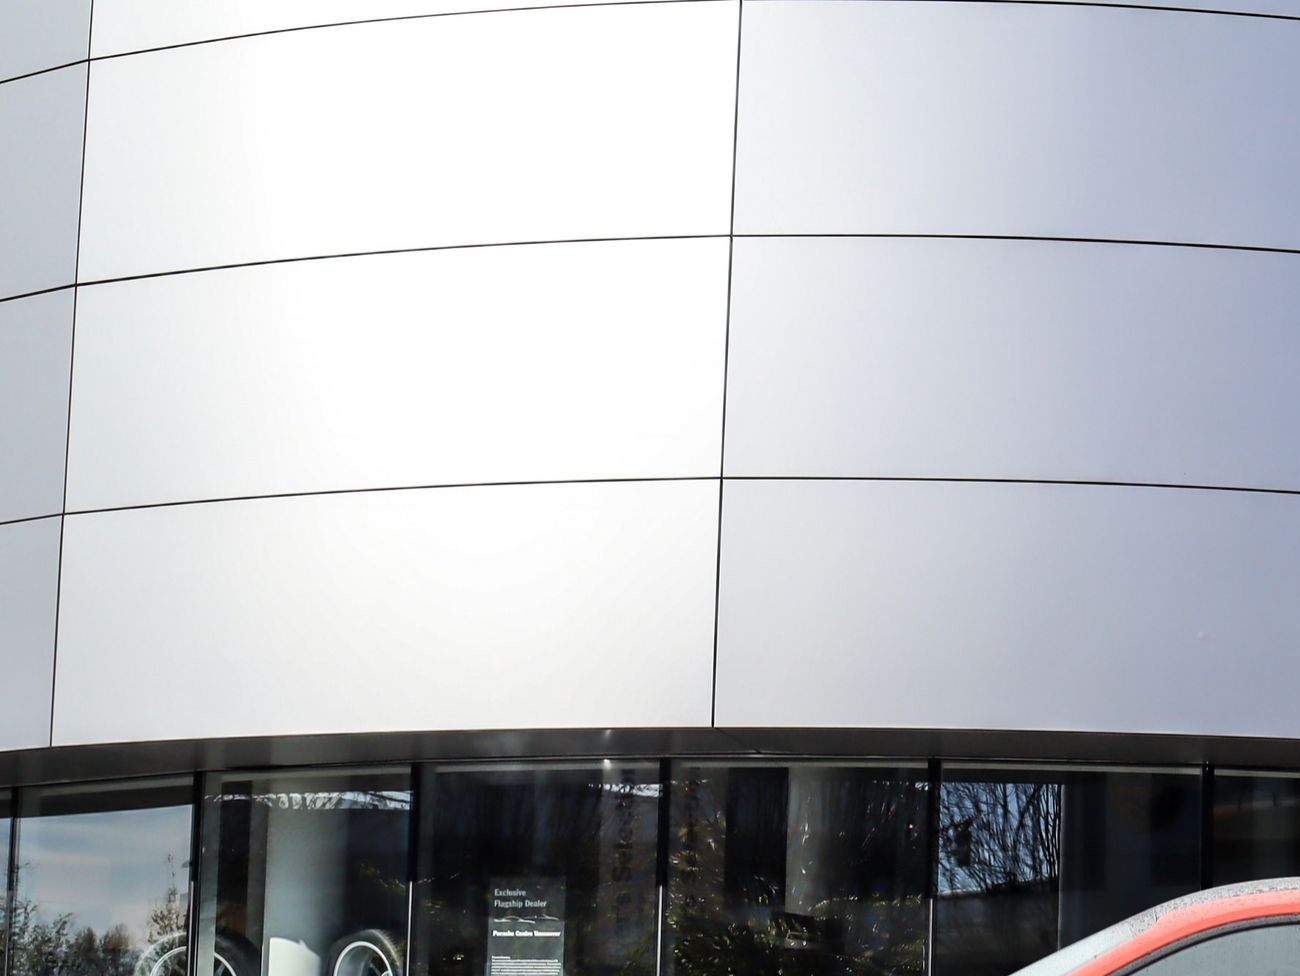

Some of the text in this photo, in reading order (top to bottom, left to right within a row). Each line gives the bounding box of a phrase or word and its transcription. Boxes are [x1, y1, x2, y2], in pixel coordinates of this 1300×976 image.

[494, 888, 527, 897] Exclusive
[494, 899, 547, 909] Flagship Dealer
